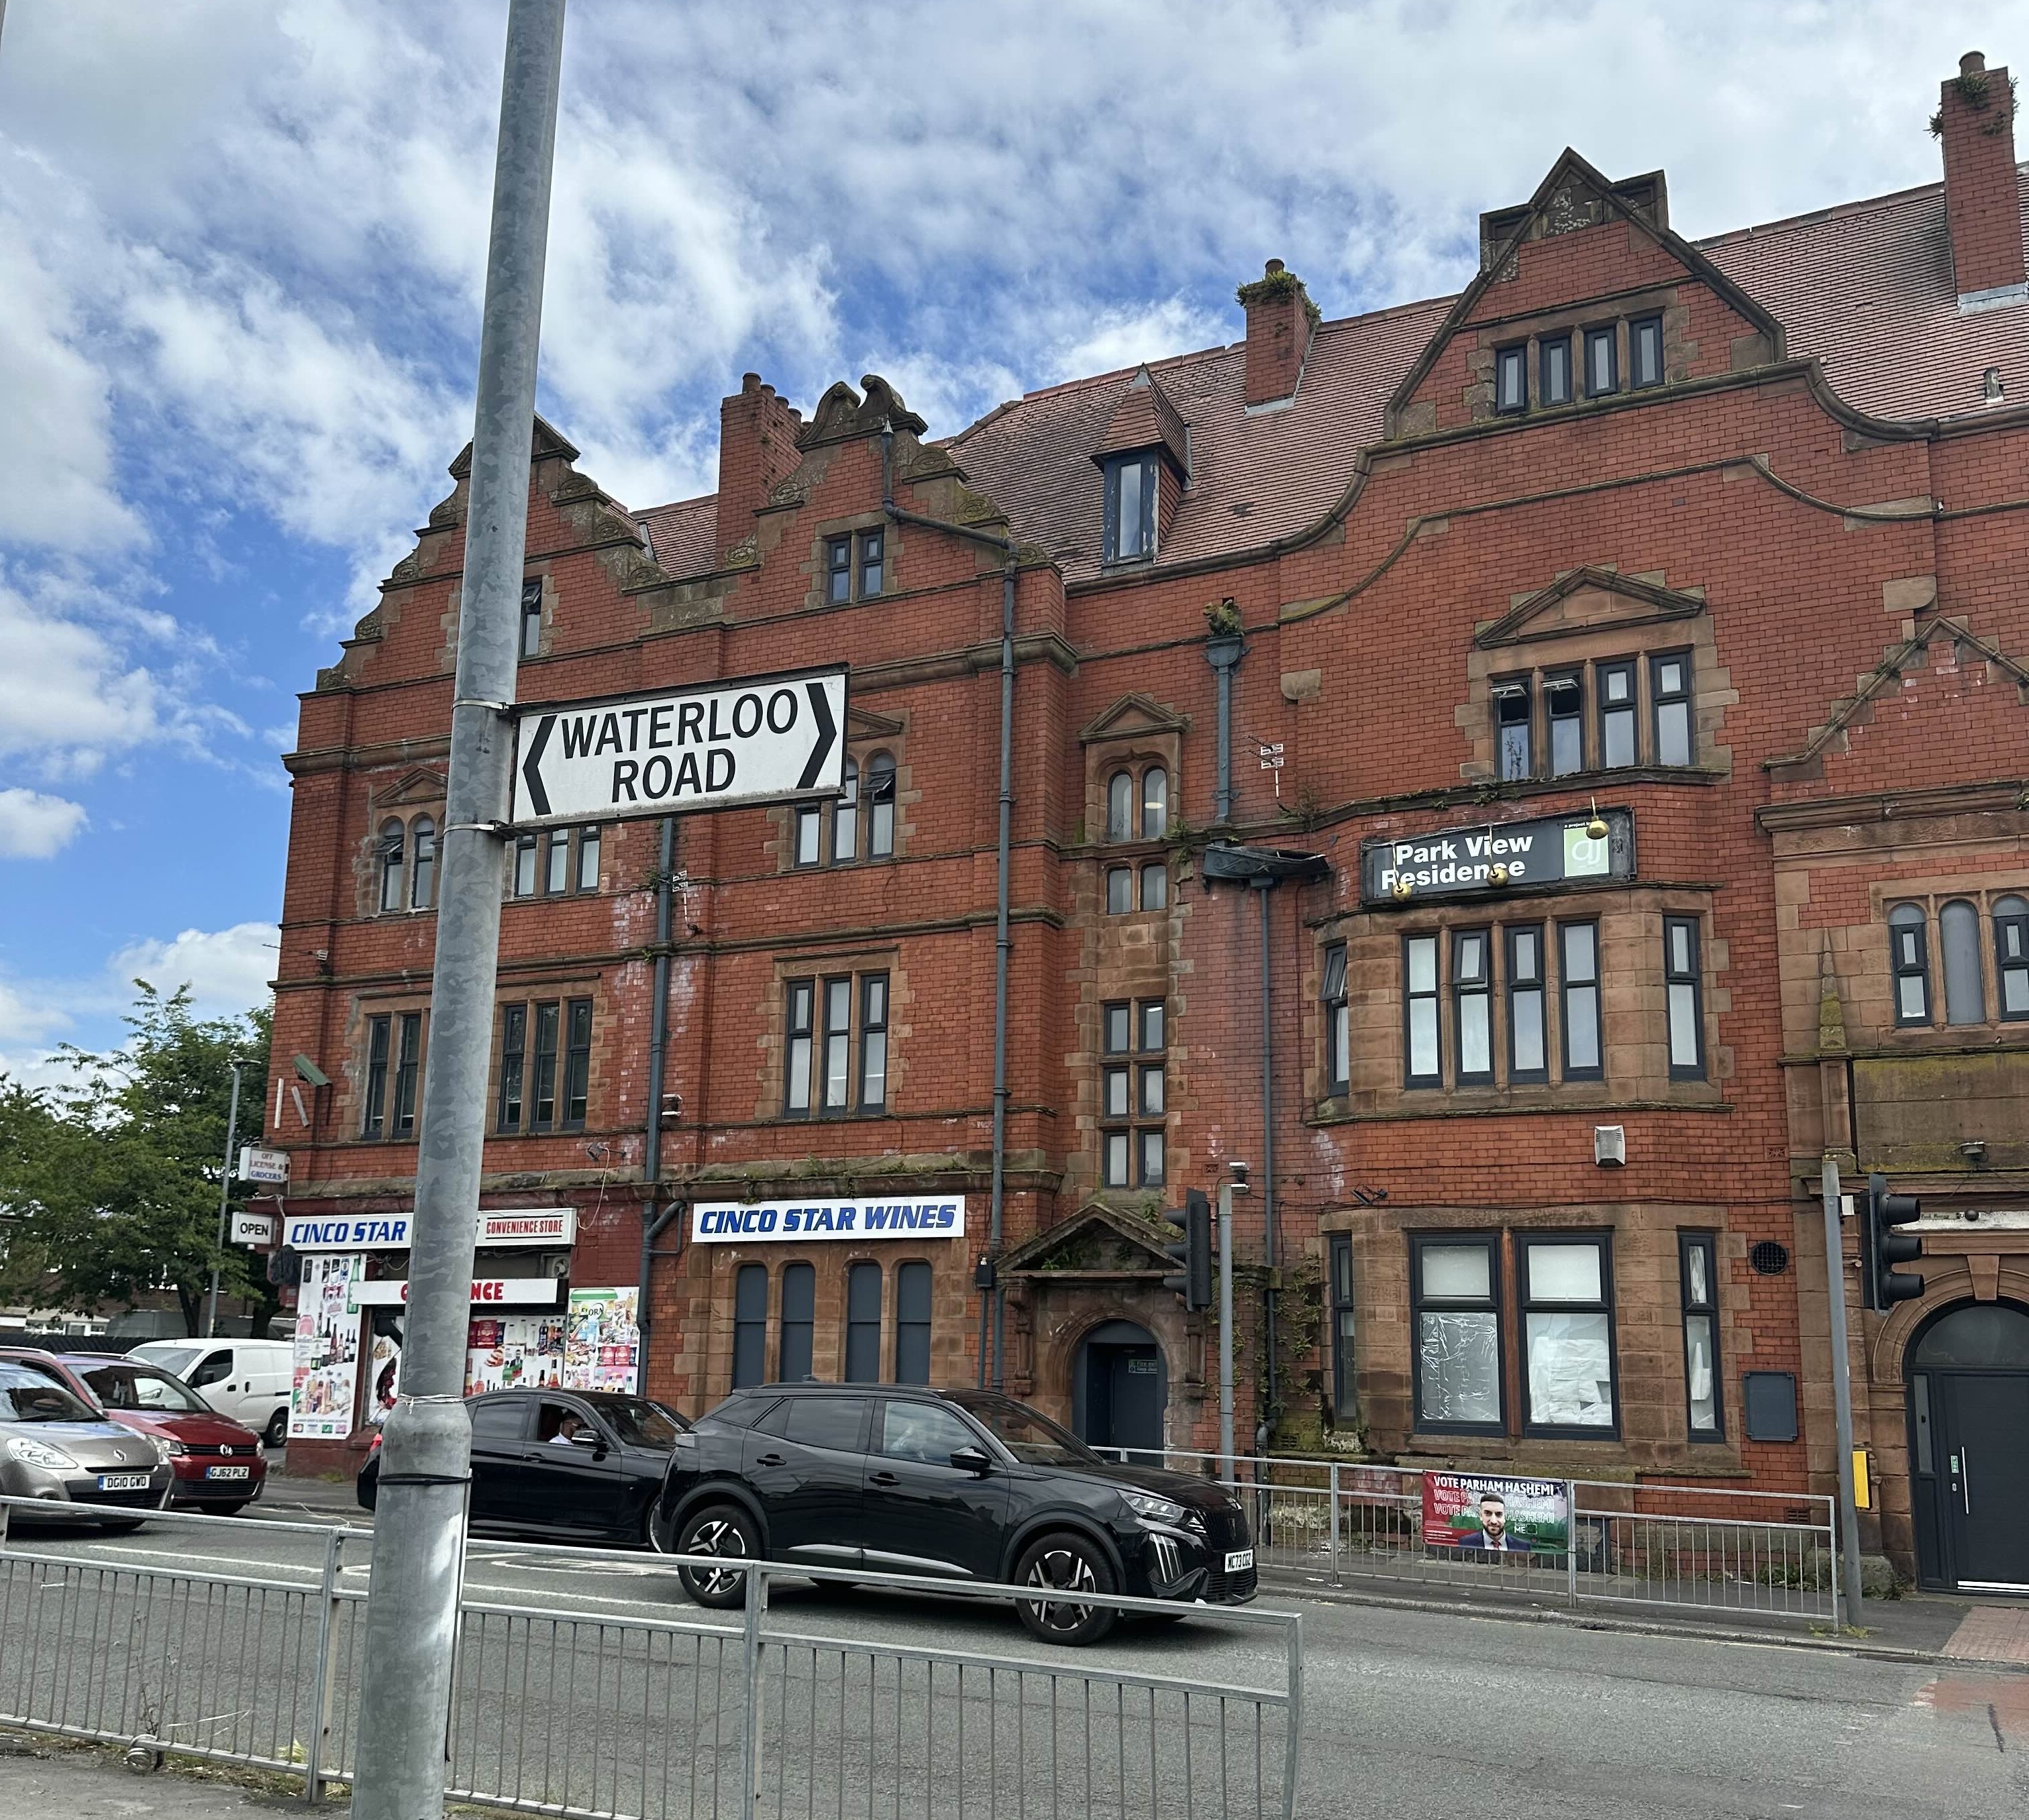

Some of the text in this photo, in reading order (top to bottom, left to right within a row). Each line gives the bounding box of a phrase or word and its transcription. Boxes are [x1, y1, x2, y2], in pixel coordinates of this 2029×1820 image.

[561, 688, 798, 759] WATERLOO
[611, 748, 736, 803] ROAD
[1396, 836, 1533, 865] Park View
[250, 1160, 276, 1169] LICENSE
[251, 1171, 282, 1180] GROCERS
[240, 1222, 269, 1236] OPEN
[486, 1220, 538, 1234] CONVENIENCE
[539, 1220, 563, 1233] STORE
[700, 1205, 957, 1234] CINCO STAR WINES
[291, 1221, 407, 1243] CINCO STAR
[107, 1477, 128, 1488] DG10
[1433, 1475, 1554, 1496] VOTE PARHAM HASHEMI
[1433, 1489, 1461, 1503] VOTE
[1505, 1493, 1555, 1510] HASHEMI
[1433, 1502, 1461, 1516] VOTE
[1505, 1509, 1555, 1523] HASHEMI
[1514, 1526, 1526, 1534] ME
